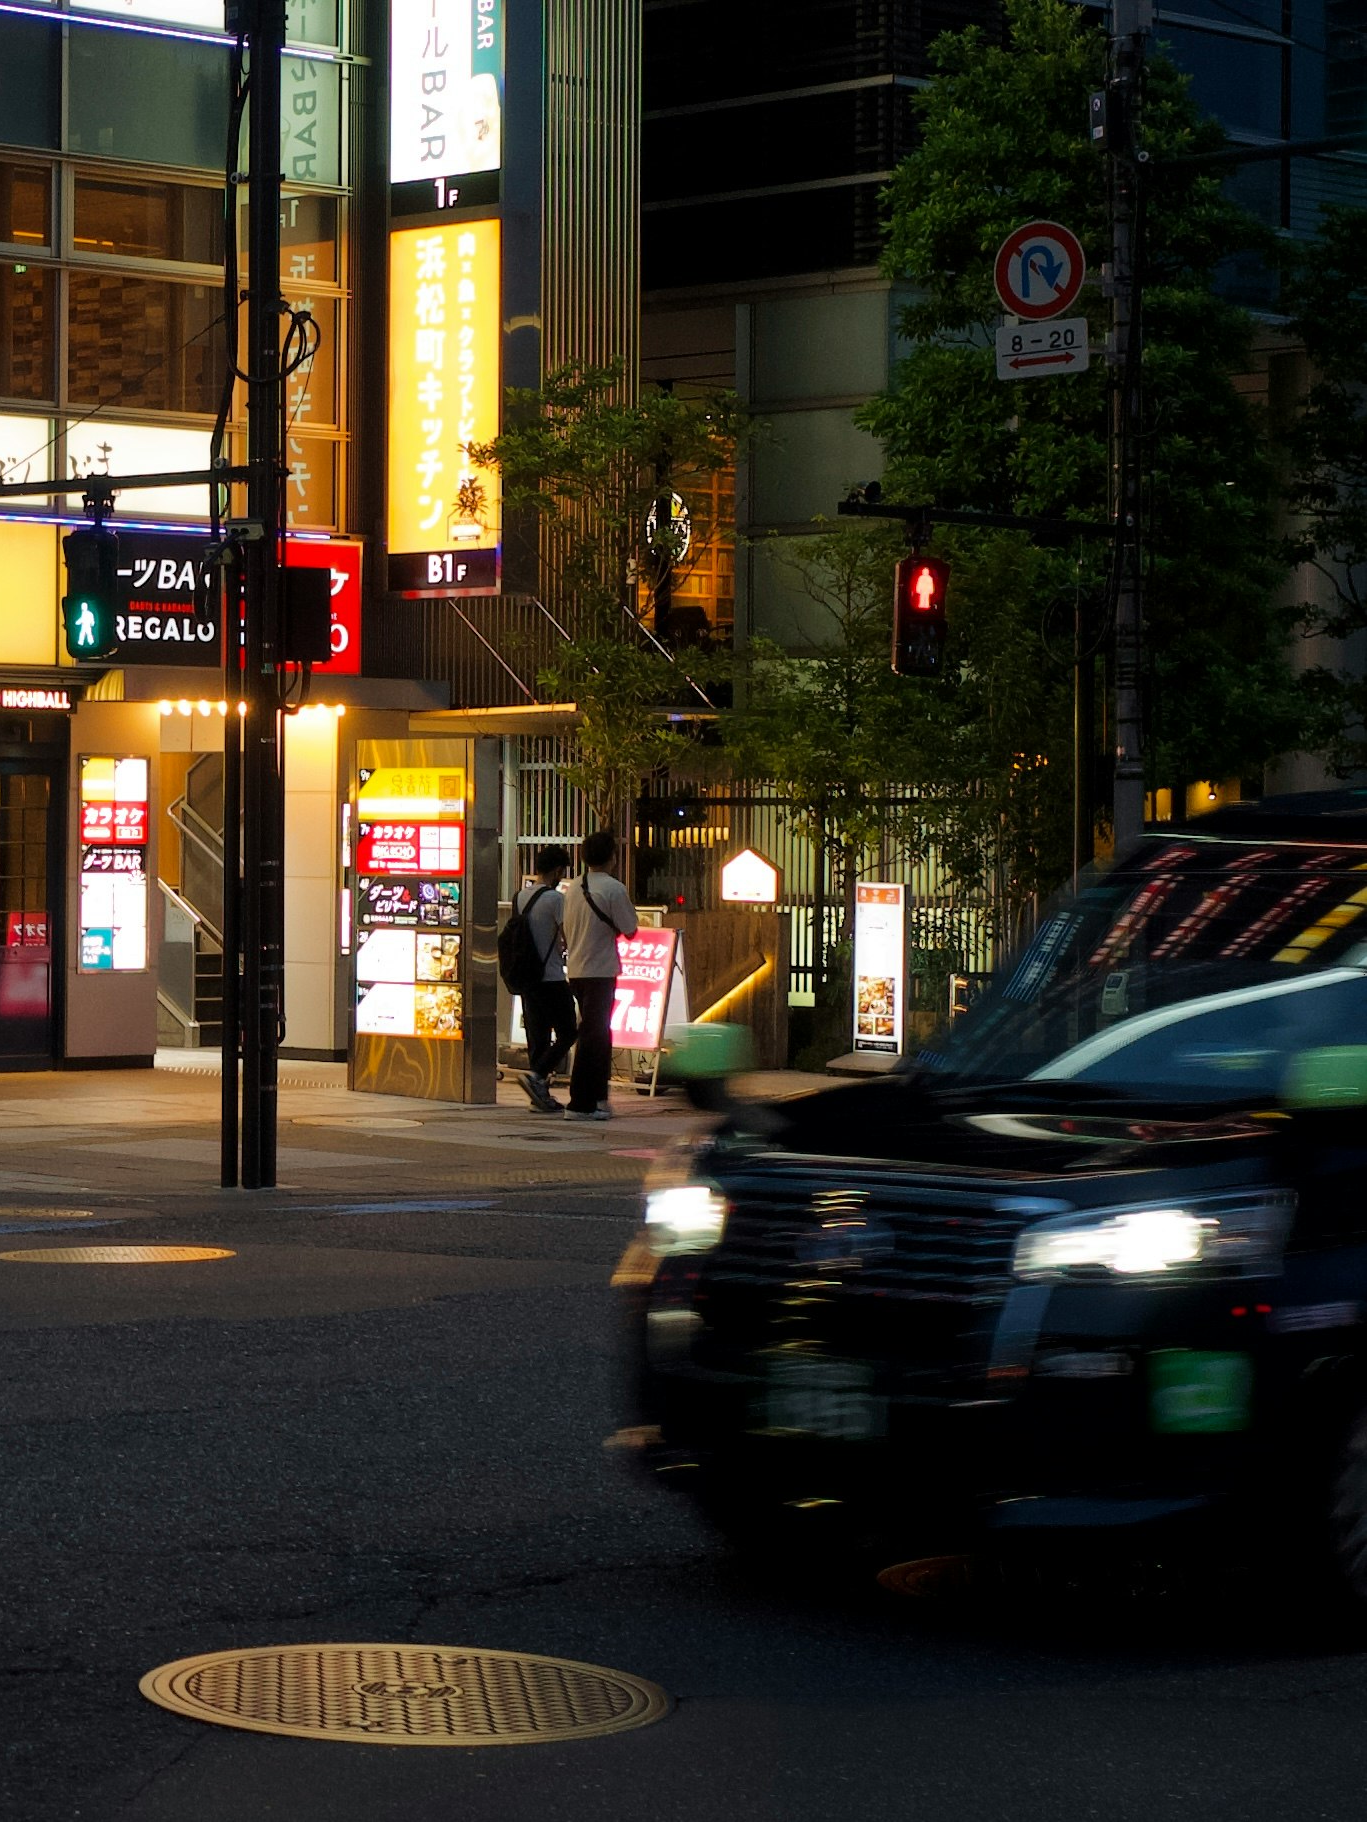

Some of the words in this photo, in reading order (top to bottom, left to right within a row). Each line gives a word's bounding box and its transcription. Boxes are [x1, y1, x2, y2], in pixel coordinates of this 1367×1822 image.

[435, 178, 459, 209] 1F
[415, 235, 447, 530] 浜松町キッチン
[428, 553, 467, 584] B1F
[2, 690, 71, 709] HIGHBALL
[84, 807, 145, 825] カラオケ
[373, 825, 416, 840] カラオケ
